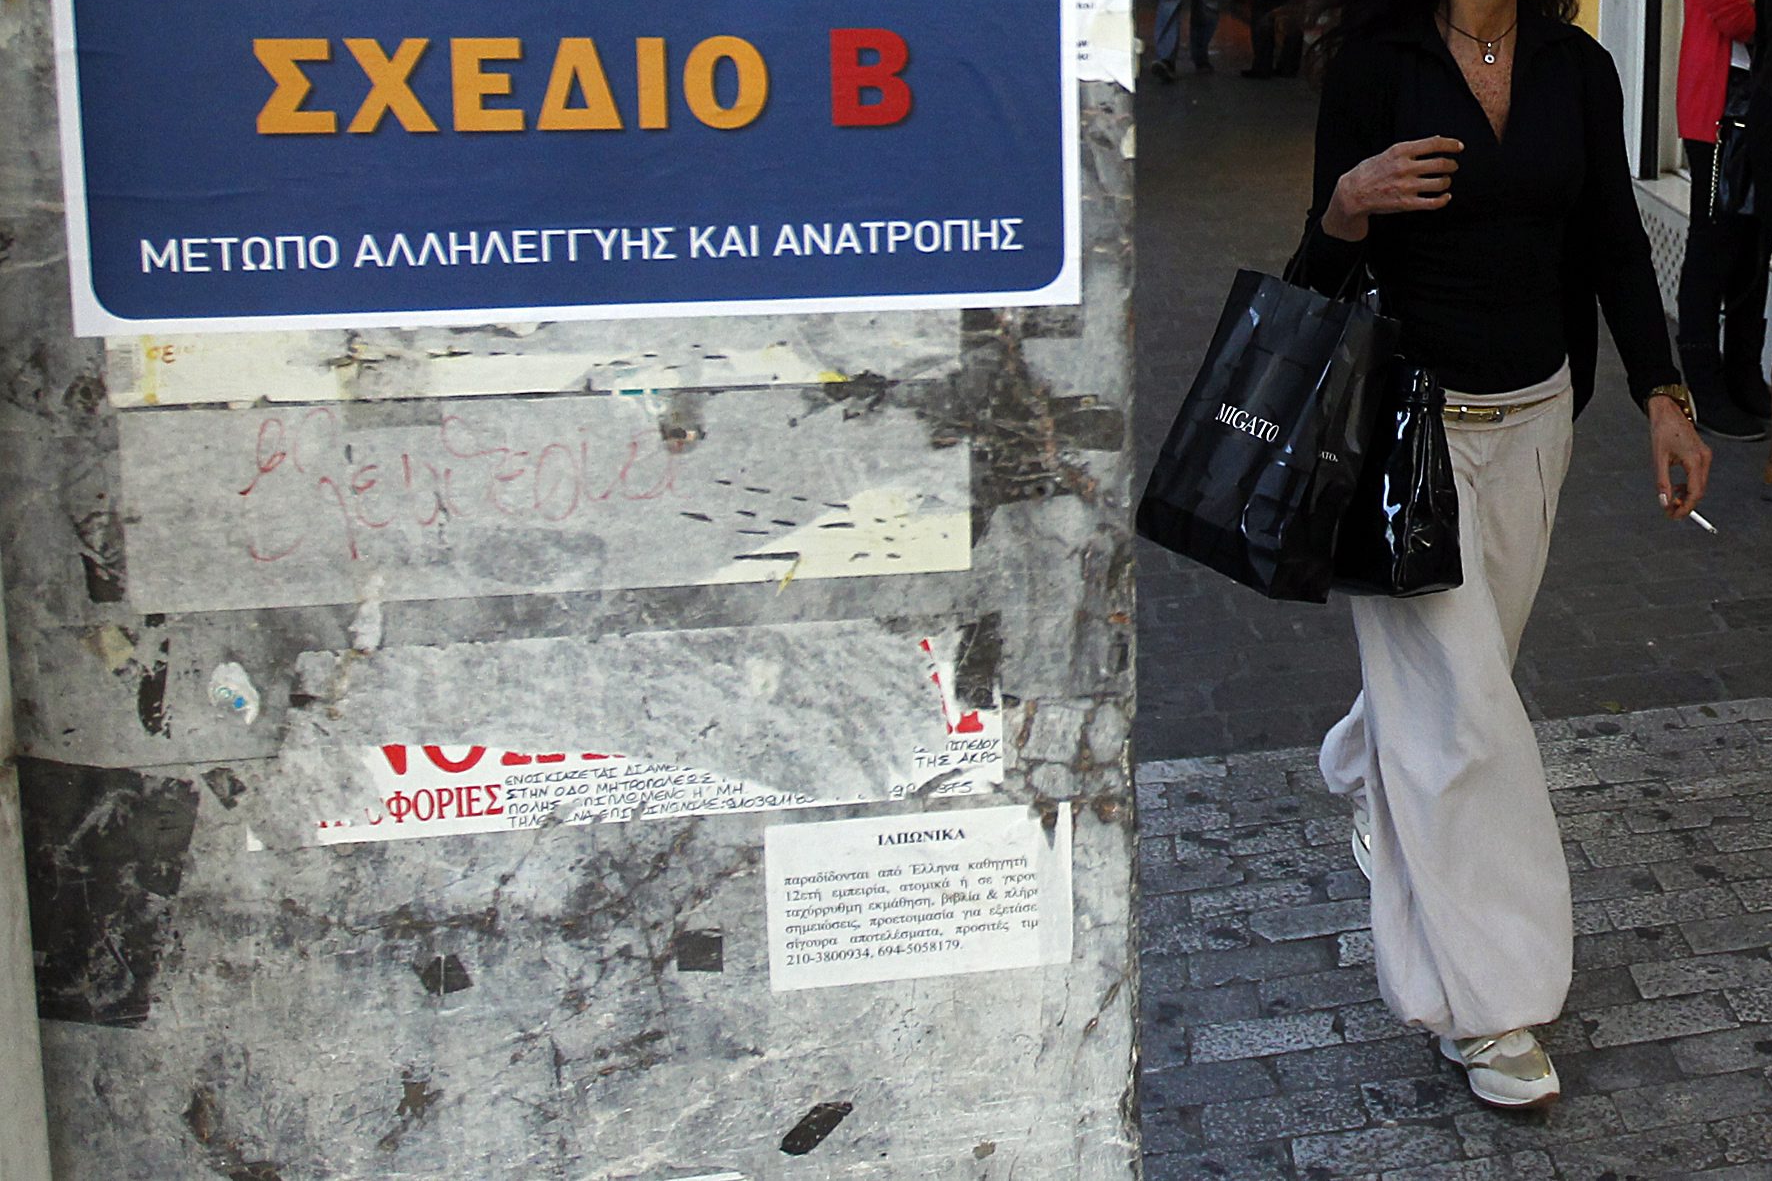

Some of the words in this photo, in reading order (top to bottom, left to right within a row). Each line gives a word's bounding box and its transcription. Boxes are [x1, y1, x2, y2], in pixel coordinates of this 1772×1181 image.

[252, 35, 769, 134] ΣΧΕΔΙΟ
[140, 234, 338, 273] ΜΕΤΩΠΟ
[353, 226, 677, 268] ΑΛΛΗΛΕΓΓΥΗΣ
[689, 224, 759, 259] ΚΑΙ
[772, 218, 1025, 257] ΑΝΑΤΡΟΠΗΣ
[1215, 402, 1280, 443] MIGATO
[877, 827, 966, 847] ΙΑΠΩΝΙΚΑ
[783, 871, 870, 888] παραδίδονται
[877, 864, 903, 879] από
[899, 877, 950, 893] ατομικά
[977, 875, 993, 886] σε
[986, 889, 998, 900] &
[962, 908, 982, 921] για
